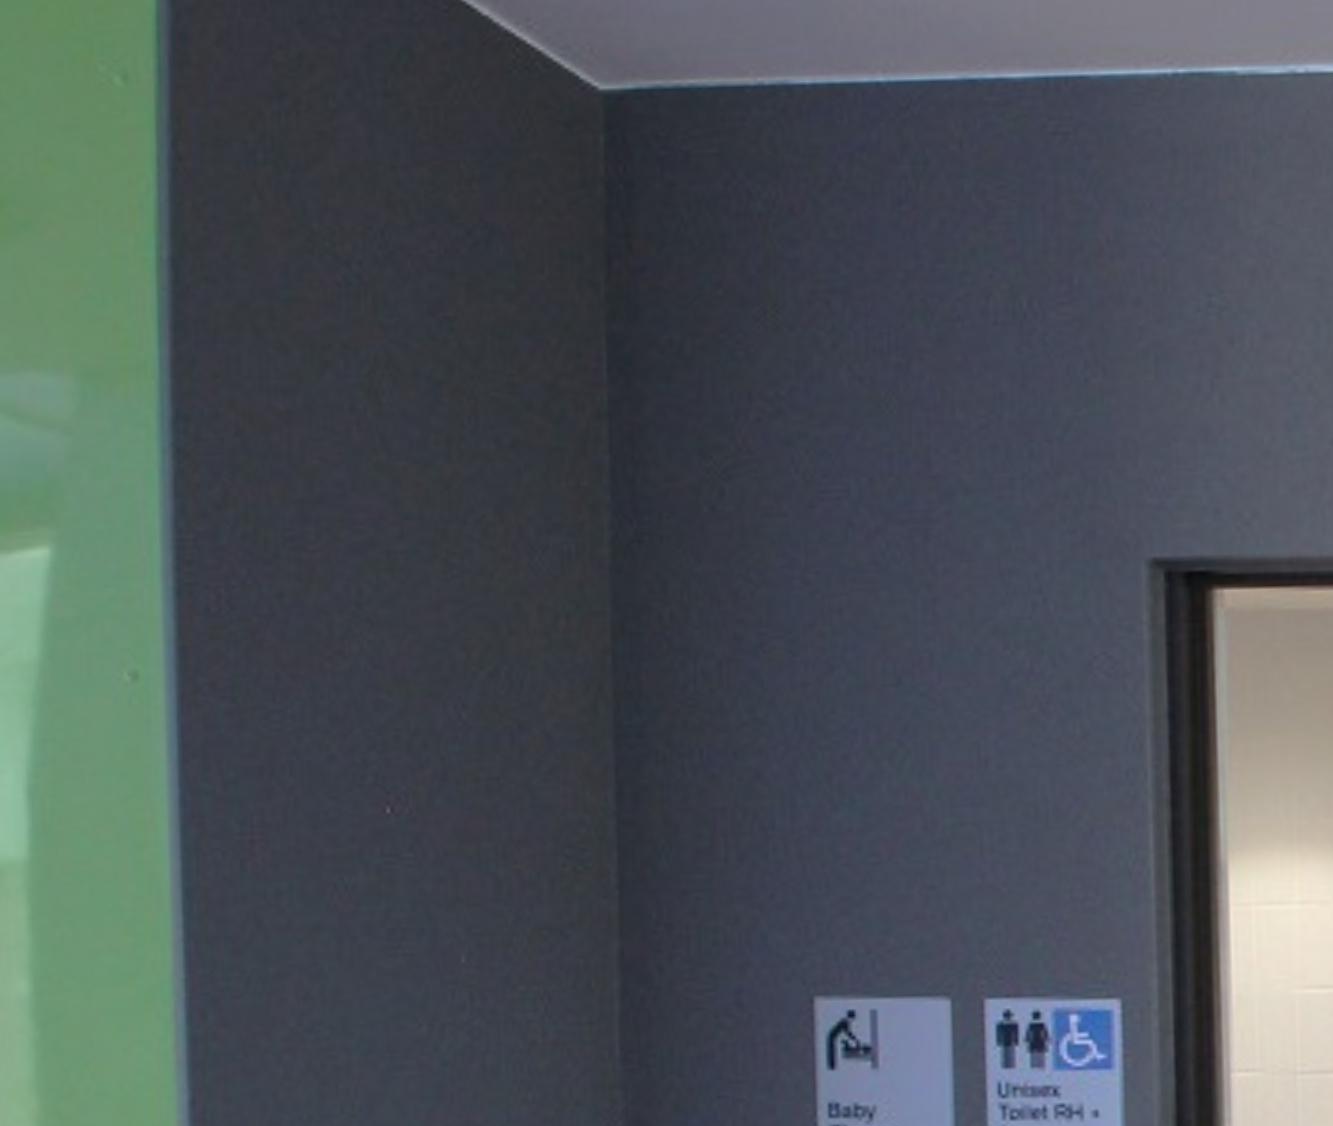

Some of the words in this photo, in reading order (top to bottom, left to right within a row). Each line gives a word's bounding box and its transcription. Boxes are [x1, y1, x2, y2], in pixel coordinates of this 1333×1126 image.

[997, 1081, 1061, 1099] Unisex
[827, 1102, 877, 1122] Baby
[998, 1103, 1048, 1120] Toilet
[1053, 1103, 1084, 1120] RH
